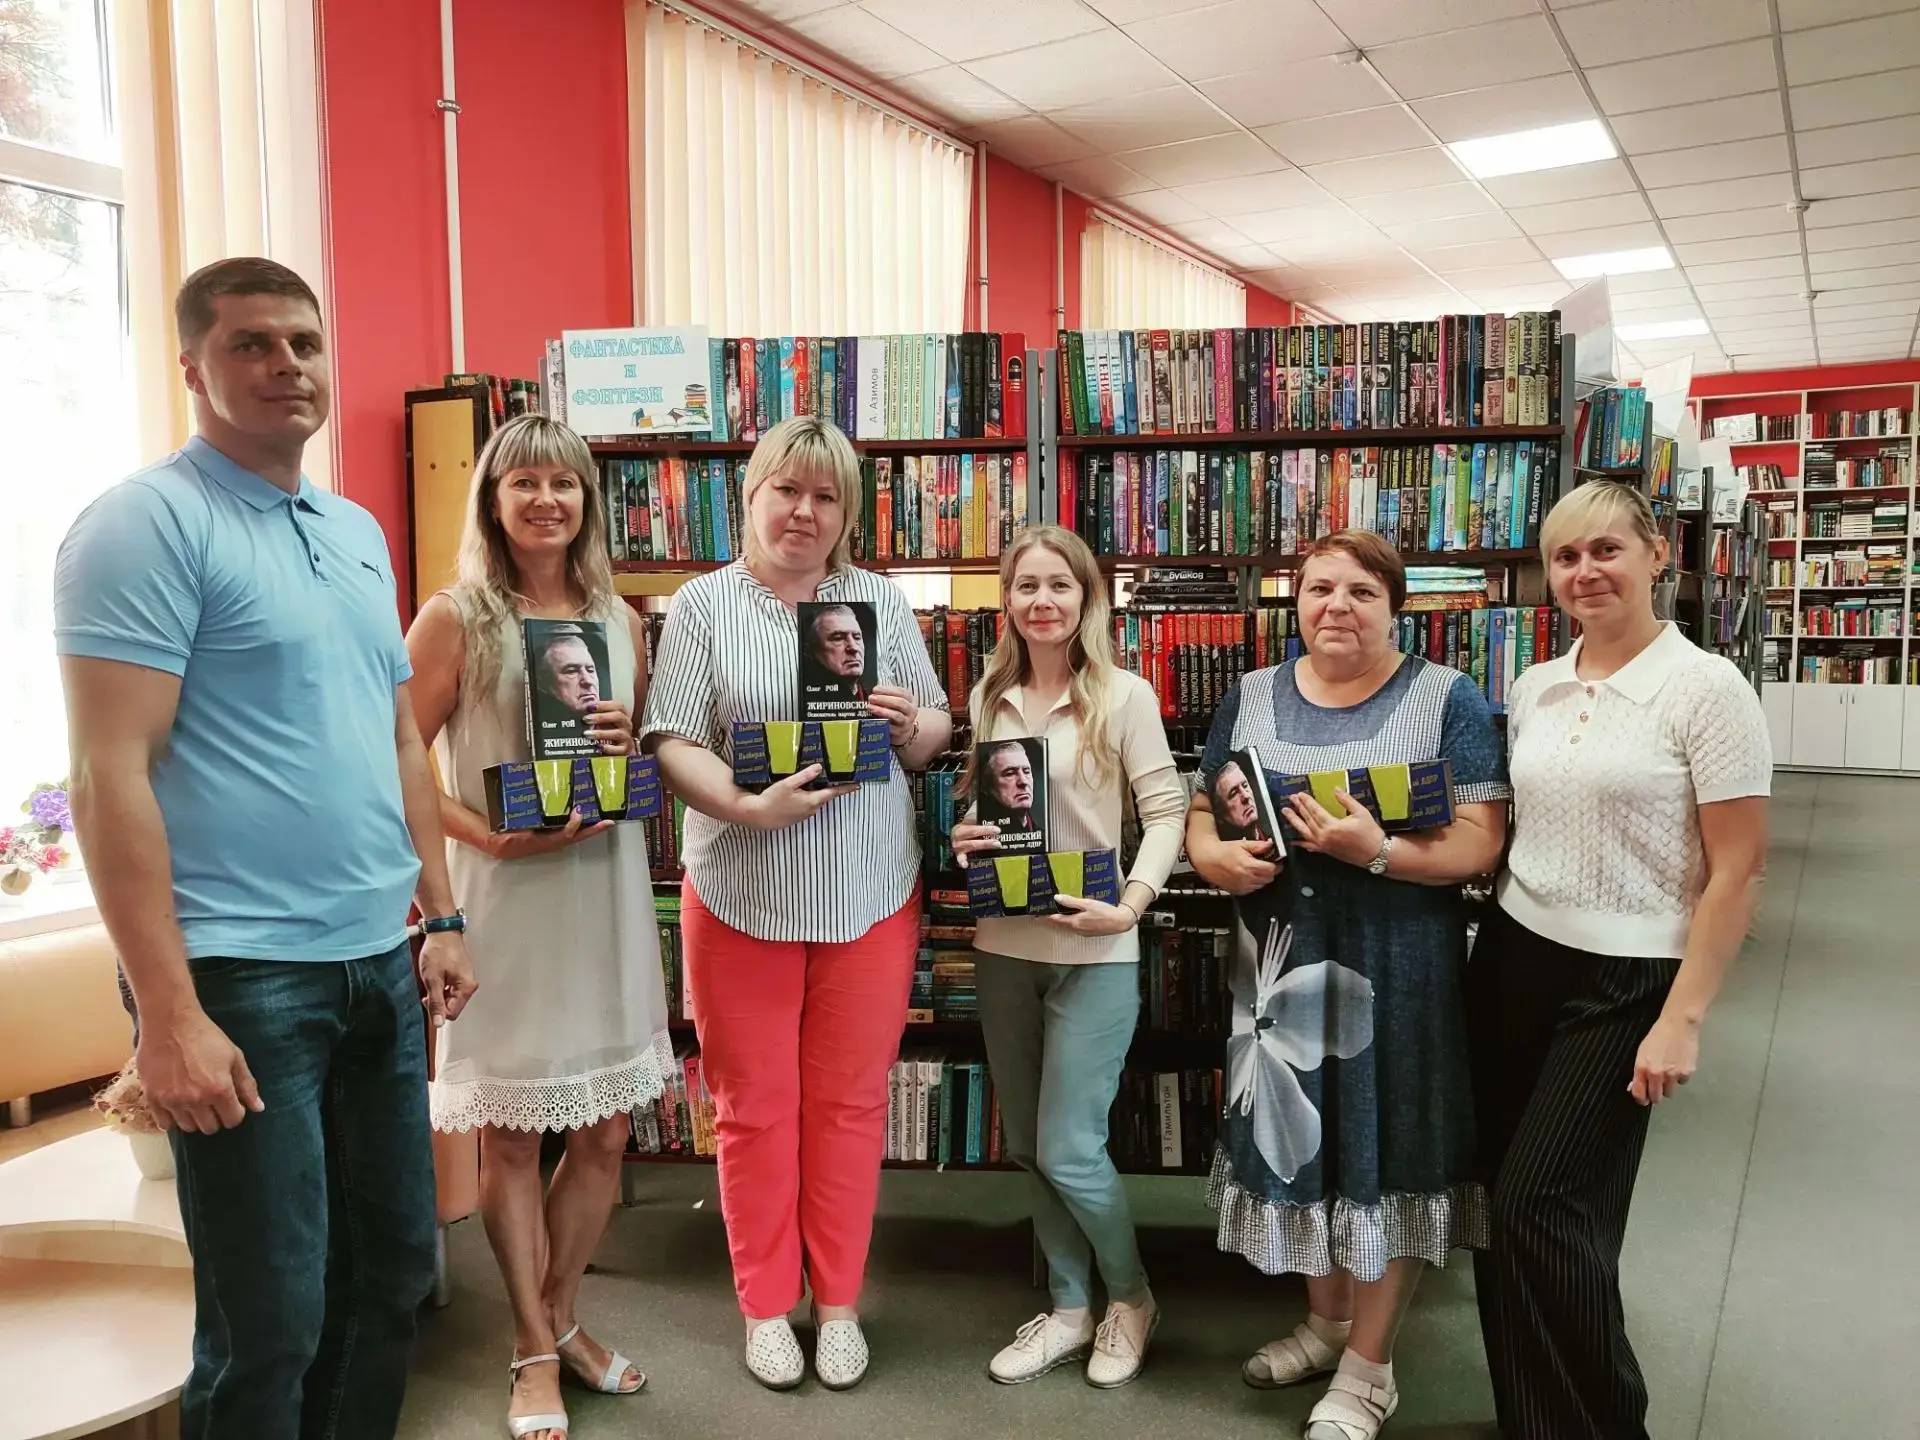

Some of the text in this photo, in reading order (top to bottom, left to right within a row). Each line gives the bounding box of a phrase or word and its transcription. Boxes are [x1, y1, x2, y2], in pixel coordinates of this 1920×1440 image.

[570, 336, 685, 358] ФАНТАСТИКА
[1490, 317, 1500, 367] ДЭН БРАУН
[1508, 324, 1516, 372] ДЭН БРАУН
[1523, 315, 1532, 365] ДЭН БРАУН
[1538, 315, 1547, 365] ДЭН БРАУН
[624, 364, 637, 378] И
[1085, 353, 1098, 394] ТЕНИ
[1098, 353, 1110, 392] ТЕНИ
[1111, 355, 1121, 393] ТЕНИ
[573, 387, 663, 405] ФЭНТЕЗИ
[868, 368, 879, 410] Азимов
[1250, 386, 1258, 429] ПРИБЫТИЕ
[1528, 464, 1543, 523] Владигор
[1211, 510, 1219, 538] БУЛЫЧЕВ
[825, 684, 839, 692] РОЙ
[1190, 672, 1199, 704] БУШКОВ
[1202, 672, 1211, 704] БУШКОВ
[561, 719, 575, 728] РОЙ
[507, 764, 532, 774] Выбира
[510, 792, 537, 804] Выбира
[998, 817, 1011, 825] РОЙ
[1026, 841, 1042, 849] ЛДПР
[970, 859, 992, 869] Выбира
[1092, 861, 1109, 872] ЛДПР
[972, 887, 997, 896] Выбира
[1095, 889, 1112, 899] ЛДПР
[1163, 1086, 1173, 1141] Гамильтон
